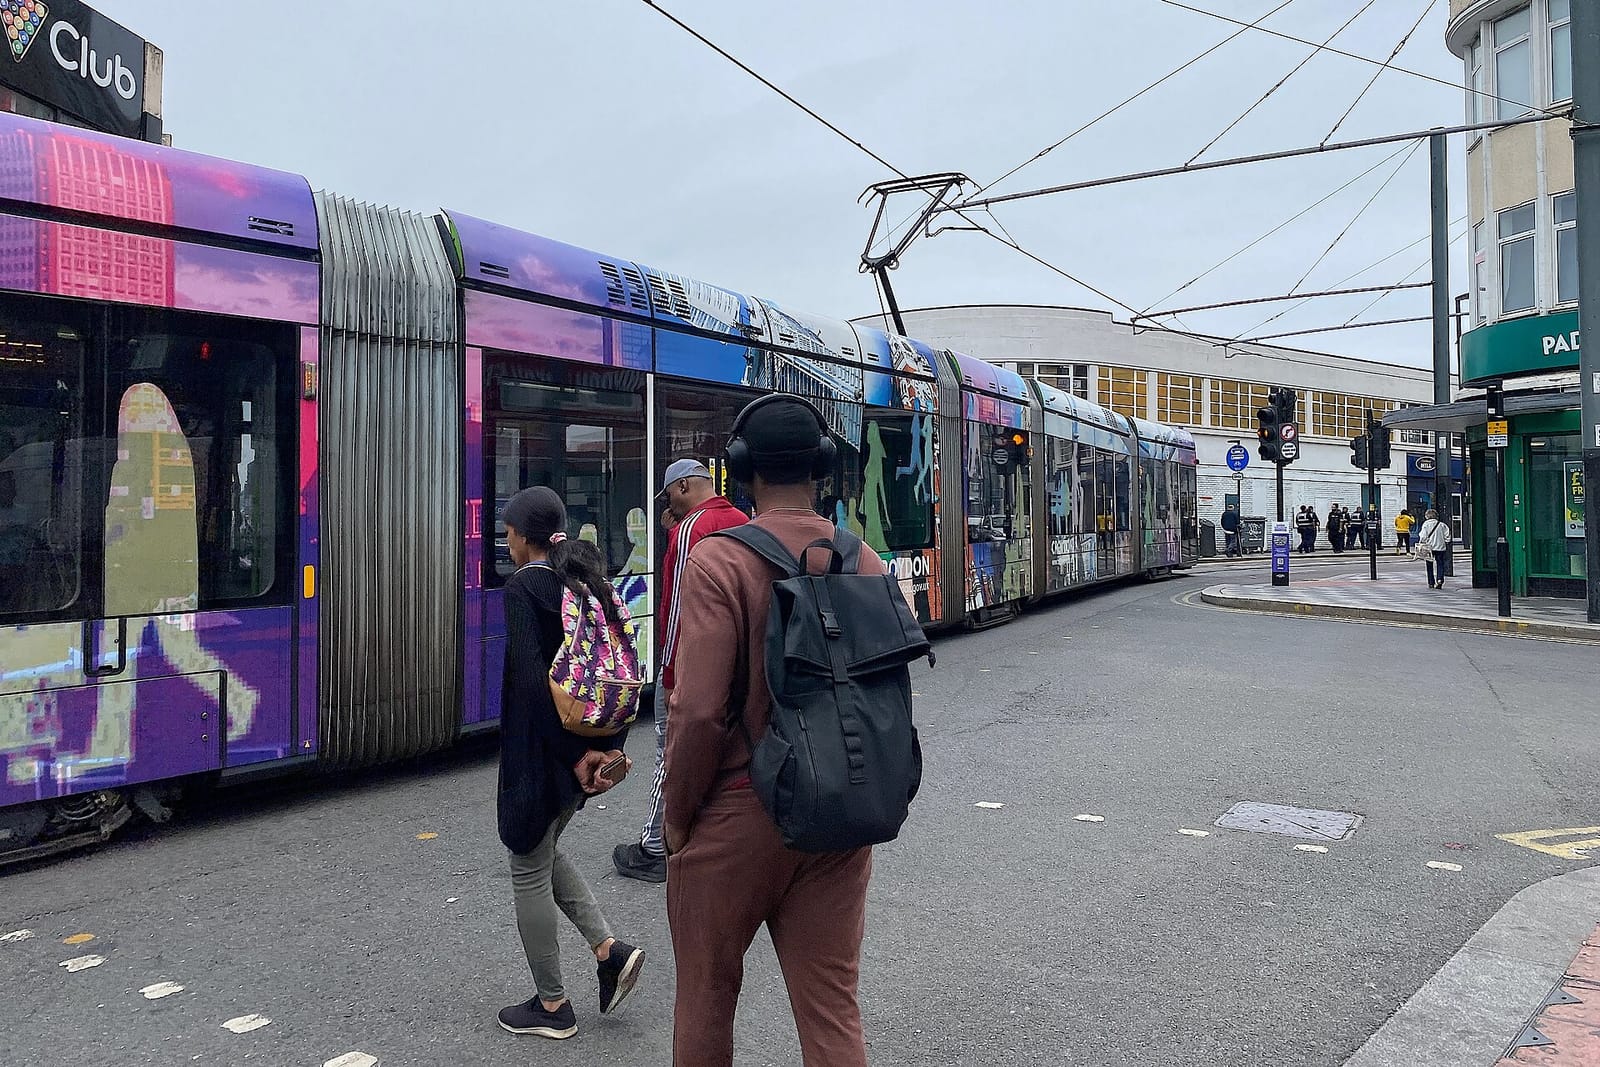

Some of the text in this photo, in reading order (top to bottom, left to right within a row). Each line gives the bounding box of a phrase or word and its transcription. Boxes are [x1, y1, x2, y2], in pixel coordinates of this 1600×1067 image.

[49, 20, 137, 100] Club
[1542, 331, 1580, 355] PAD
[1572, 486, 1584, 495] FR
[883, 556, 930, 578] OYDON
